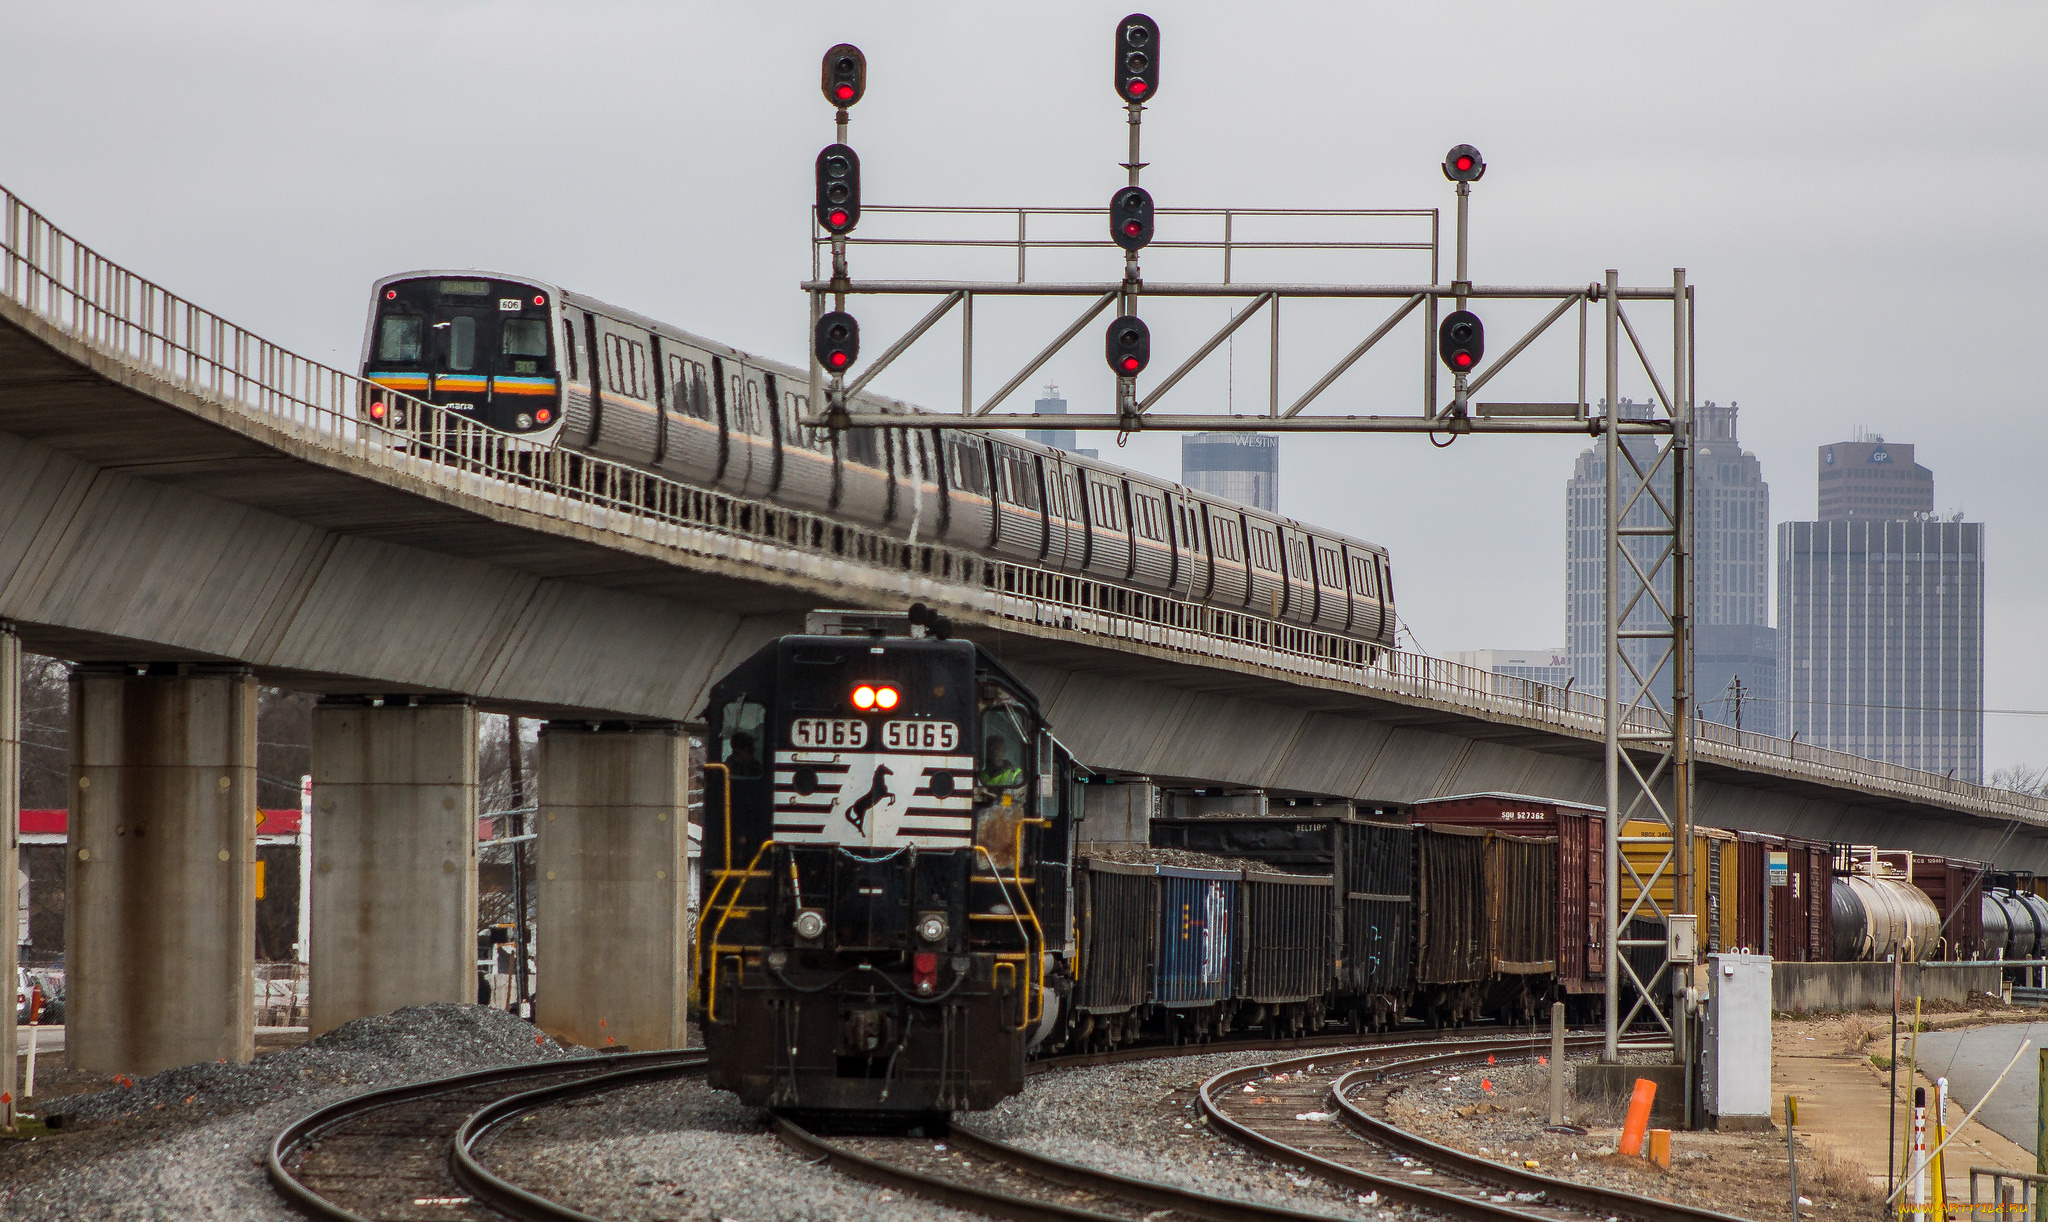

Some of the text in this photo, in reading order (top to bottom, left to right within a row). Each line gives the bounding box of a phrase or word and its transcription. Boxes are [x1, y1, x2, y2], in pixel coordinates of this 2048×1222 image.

[502, 301, 519, 309] 606
[1873, 452, 1888, 462] GP
[798, 721, 862, 746] 5065
[889, 722, 953, 748] 5065
